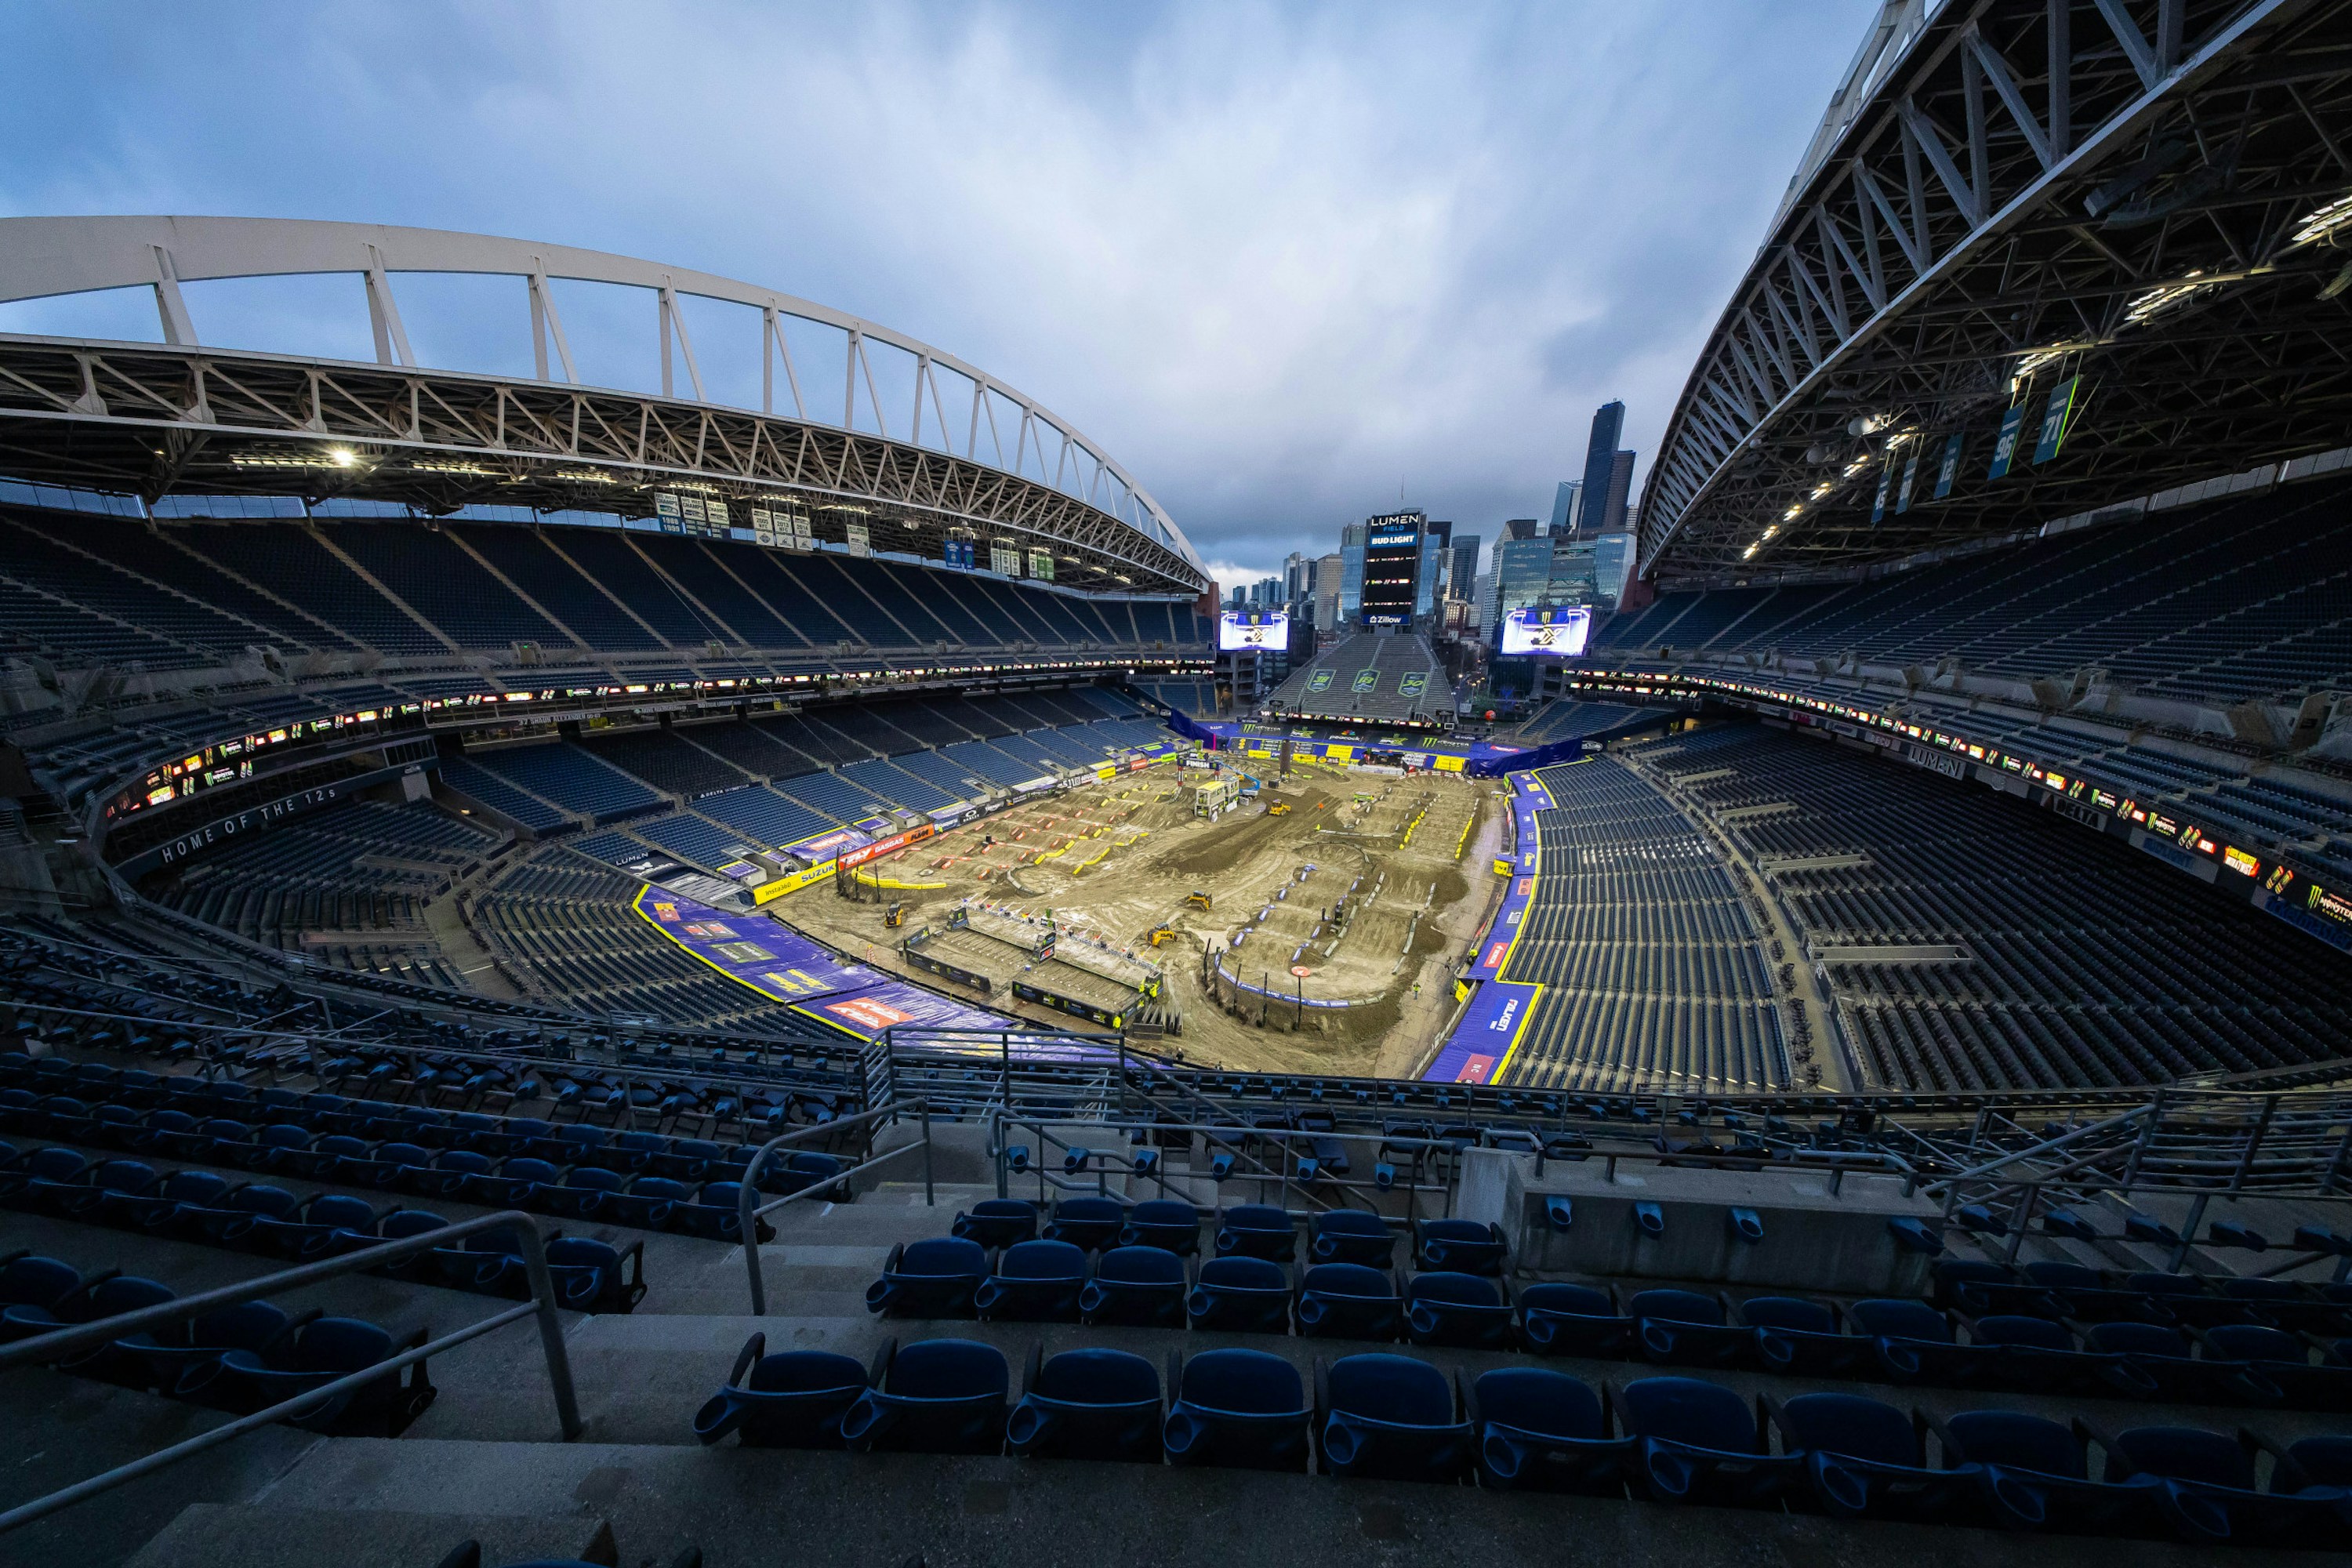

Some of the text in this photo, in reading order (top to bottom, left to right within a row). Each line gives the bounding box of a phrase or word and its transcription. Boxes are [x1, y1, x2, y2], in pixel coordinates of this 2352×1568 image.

[2042, 412, 2063, 445] 71
[1994, 432, 2015, 463] 96
[1940, 459, 1955, 483] 12
[1371, 514, 1419, 526] LUMEN
[1389, 535, 1414, 543] LIGHT
[553, 713, 586, 722] ALEXANDER
[2056, 798, 2099, 828] DELTA
[162, 789, 336, 863] HOME OF THE 12s
[909, 829, 929, 841] KTM
[874, 837, 905, 853] GASGAS
[615, 852, 648, 866] LUMEN
[839, 848, 872, 865] FLY
[801, 864, 836, 883] SUZUK
[1496, 998, 1519, 1032] FALKEN
